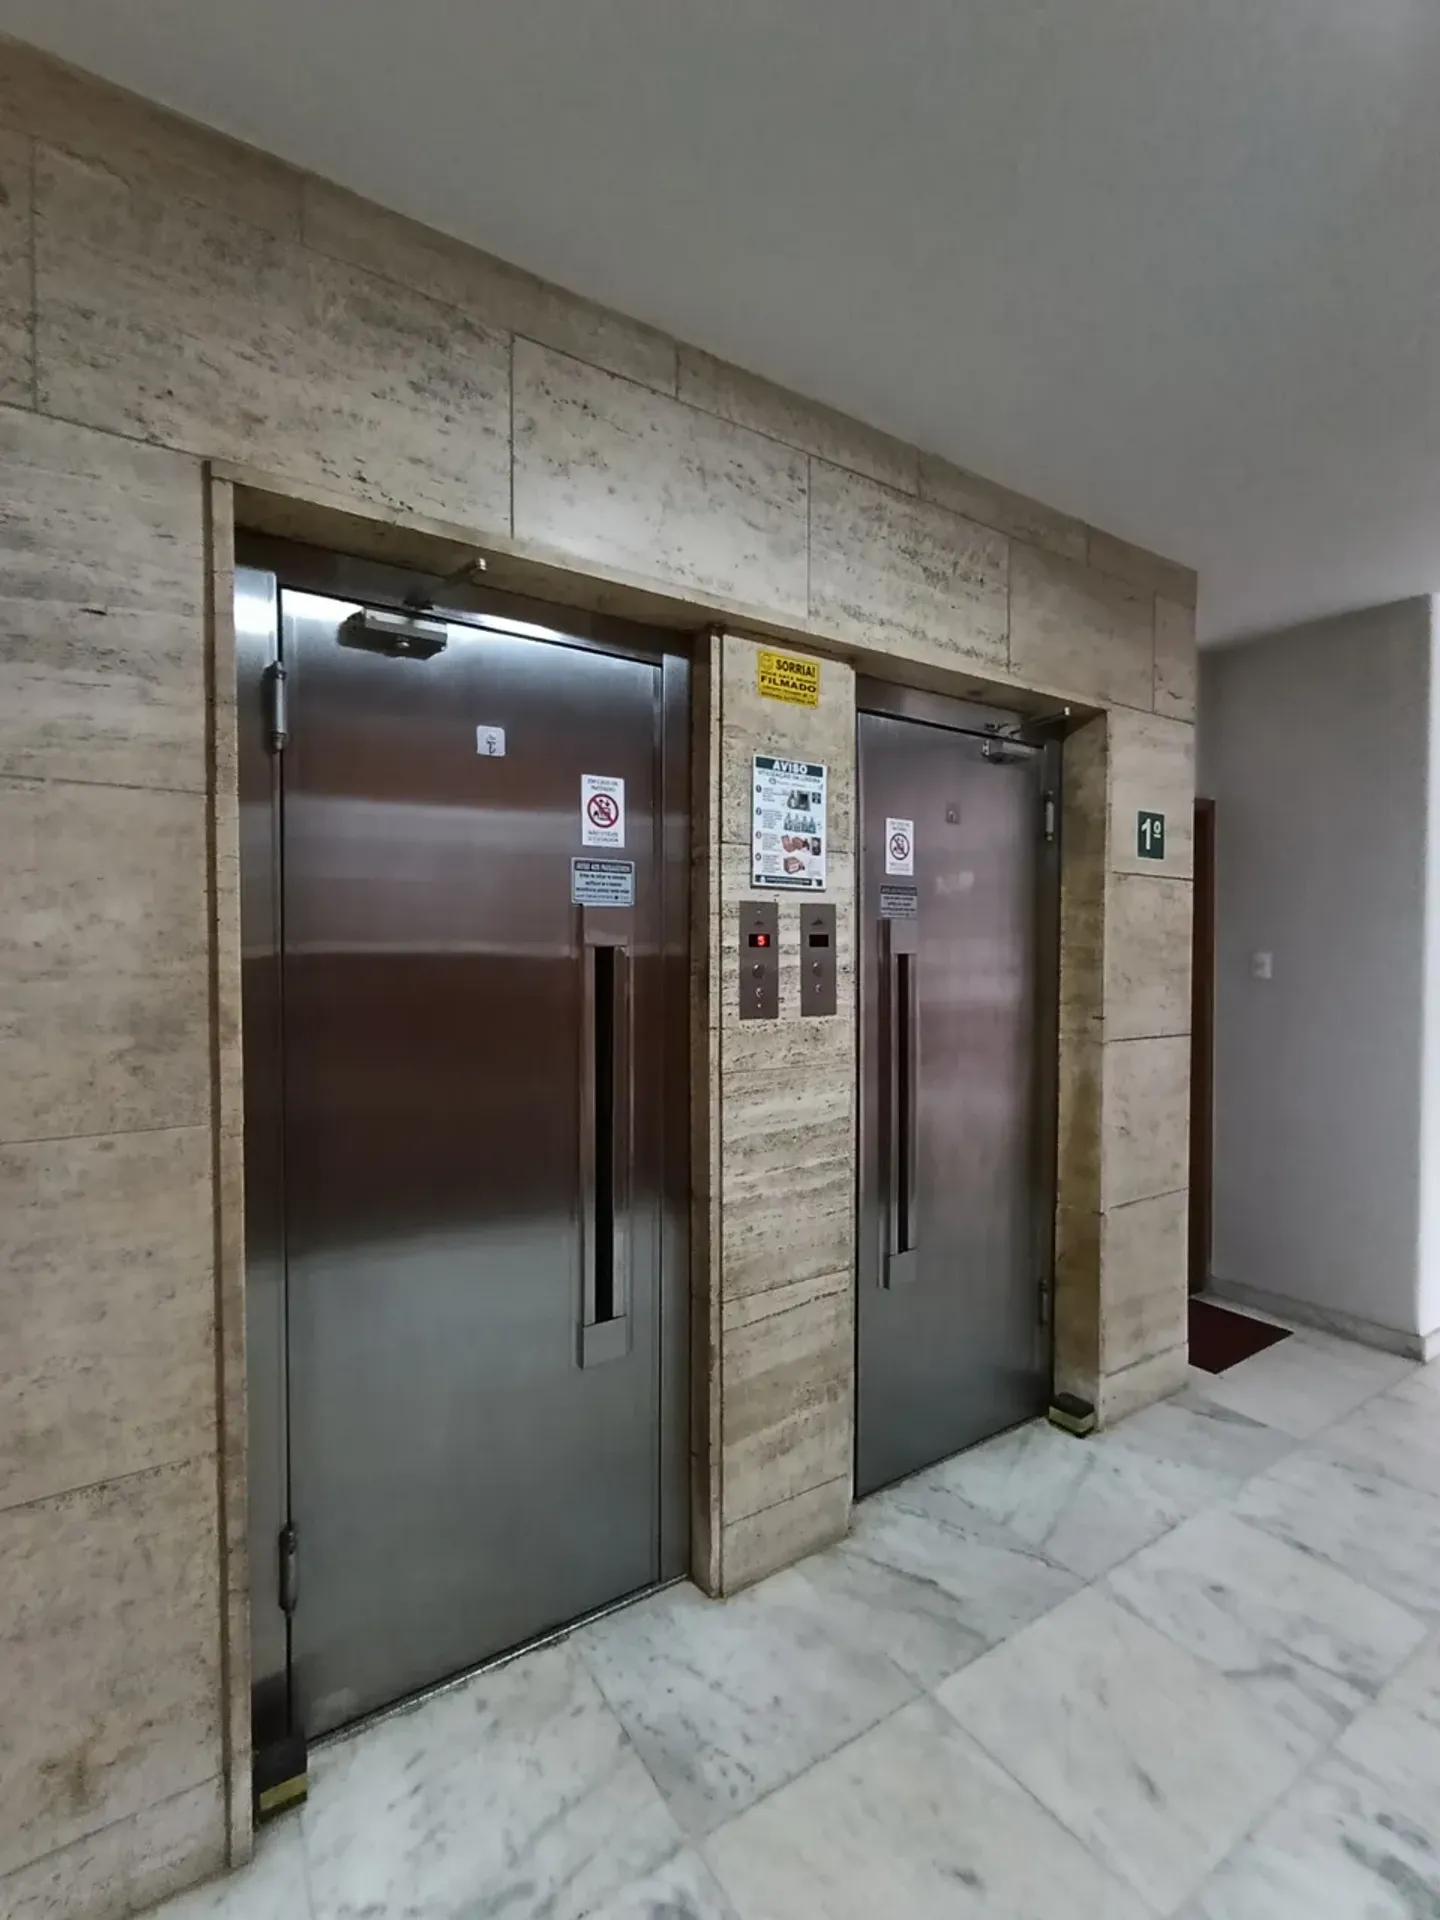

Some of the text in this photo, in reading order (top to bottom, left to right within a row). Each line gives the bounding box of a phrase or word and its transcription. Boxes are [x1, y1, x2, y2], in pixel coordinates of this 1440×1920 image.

[776, 659, 816, 678] SORRIA!
[760, 675, 817, 693] FILMADO
[772, 760, 809, 774] AVISO
[1141, 818, 1162, 850] 1º
